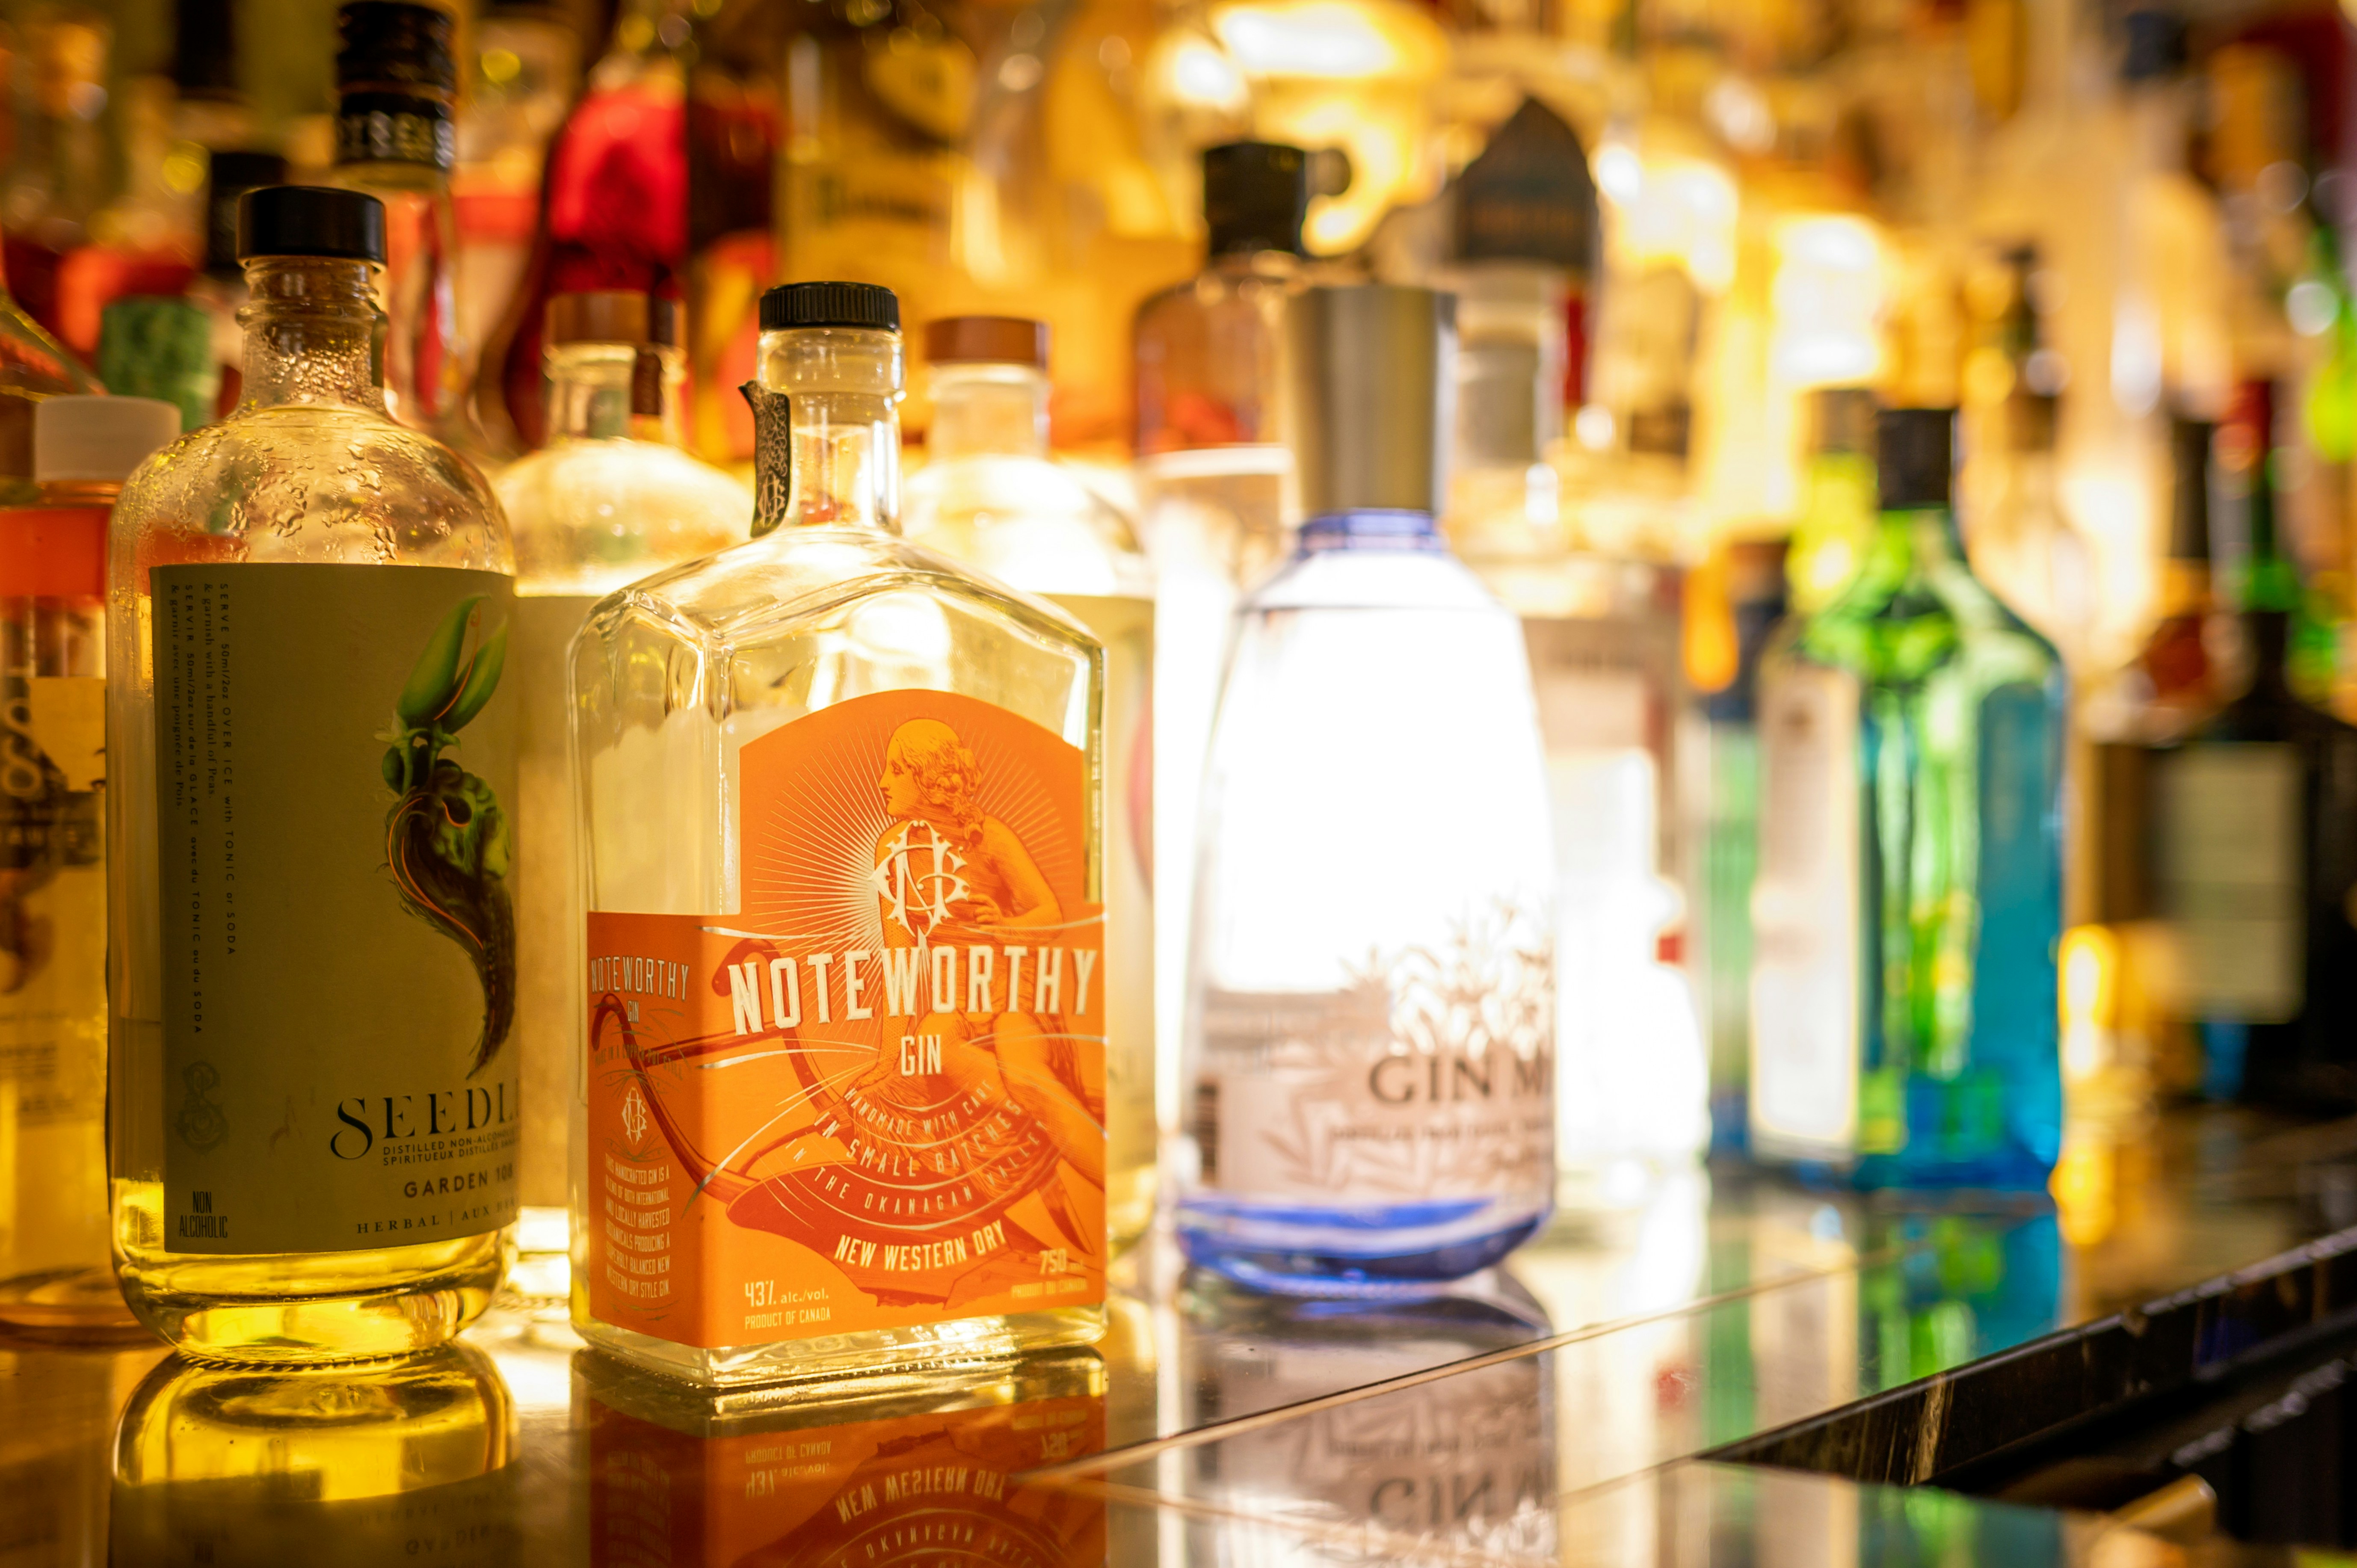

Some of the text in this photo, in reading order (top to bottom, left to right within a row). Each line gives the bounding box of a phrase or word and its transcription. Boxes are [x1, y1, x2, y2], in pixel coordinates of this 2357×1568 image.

[204, 583, 213, 592] &
[169, 599, 181, 639] garnir
[186, 584, 194, 641] SERVIR
[202, 598, 215, 646] garnish
[206, 651, 216, 678] with
[187, 653, 195, 708] 50ml/2oz
[172, 705, 183, 756] poignée
[207, 695, 217, 745] handful
[189, 736, 196, 749] de
[175, 760, 184, 776] de
[189, 755, 197, 765] la
[207, 750, 218, 764] of
[220, 583, 236, 955] SERVE 50ml/2oz OVER ICE with TONIC or SODA
[208, 768, 217, 799] Peas.
[190, 773, 198, 825] GLACE
[192, 869, 199, 883] du
[192, 891, 201, 941] TONIC
[193, 950, 199, 963] ou
[194, 968, 201, 982] du
[591, 956, 689, 1001] NOTEWORTHY
[728, 944, 1098, 1036] NOTEWORTHY
[627, 1000, 640, 1024] GIN
[900, 1034, 942, 1077] GIN
[1369, 1054, 1493, 1105] GIN
[844, 1079, 993, 1136] HANDMADE WITH CARE
[383, 1141, 445, 1155] DISTILLED
[814, 1099, 1022, 1177] IN SMALL BATCHES
[383, 1150, 454, 1166] SPIRITUEUX
[785, 1120, 1047, 1215] IN THE OKANAGAN VALLEY
[404, 1170, 489, 1198] GARDEN
[648, 1169, 657, 1184] GIN
[658, 1166, 665, 1183] IS
[666, 1163, 670, 1180] A
[192, 1191, 212, 1213] NON
[636, 1186, 670, 1206] INTERNATIONAL
[179, 1215, 228, 1238] ALCOHOLIC
[357, 1215, 440, 1234] HERBAL
[461, 1206, 490, 1222] AUX
[615, 1202, 637, 1228] LOCALLY
[638, 1207, 670, 1229] HARVESTED
[634, 1233, 665, 1252] PRODUCING
[666, 1231, 671, 1248] A
[834, 1219, 1007, 1272] NEW WESTERN DRY
[606, 1240, 671, 1275] ERBLY BALANCED NEW
[1039, 1248, 1068, 1275] 750
[629, 1278, 640, 1297] DRY
[640, 1281, 658, 1299] STYLE
[780, 1287, 829, 1305] alc./vol.
[745, 1307, 831, 1330] PRODUCT OF CANADA
